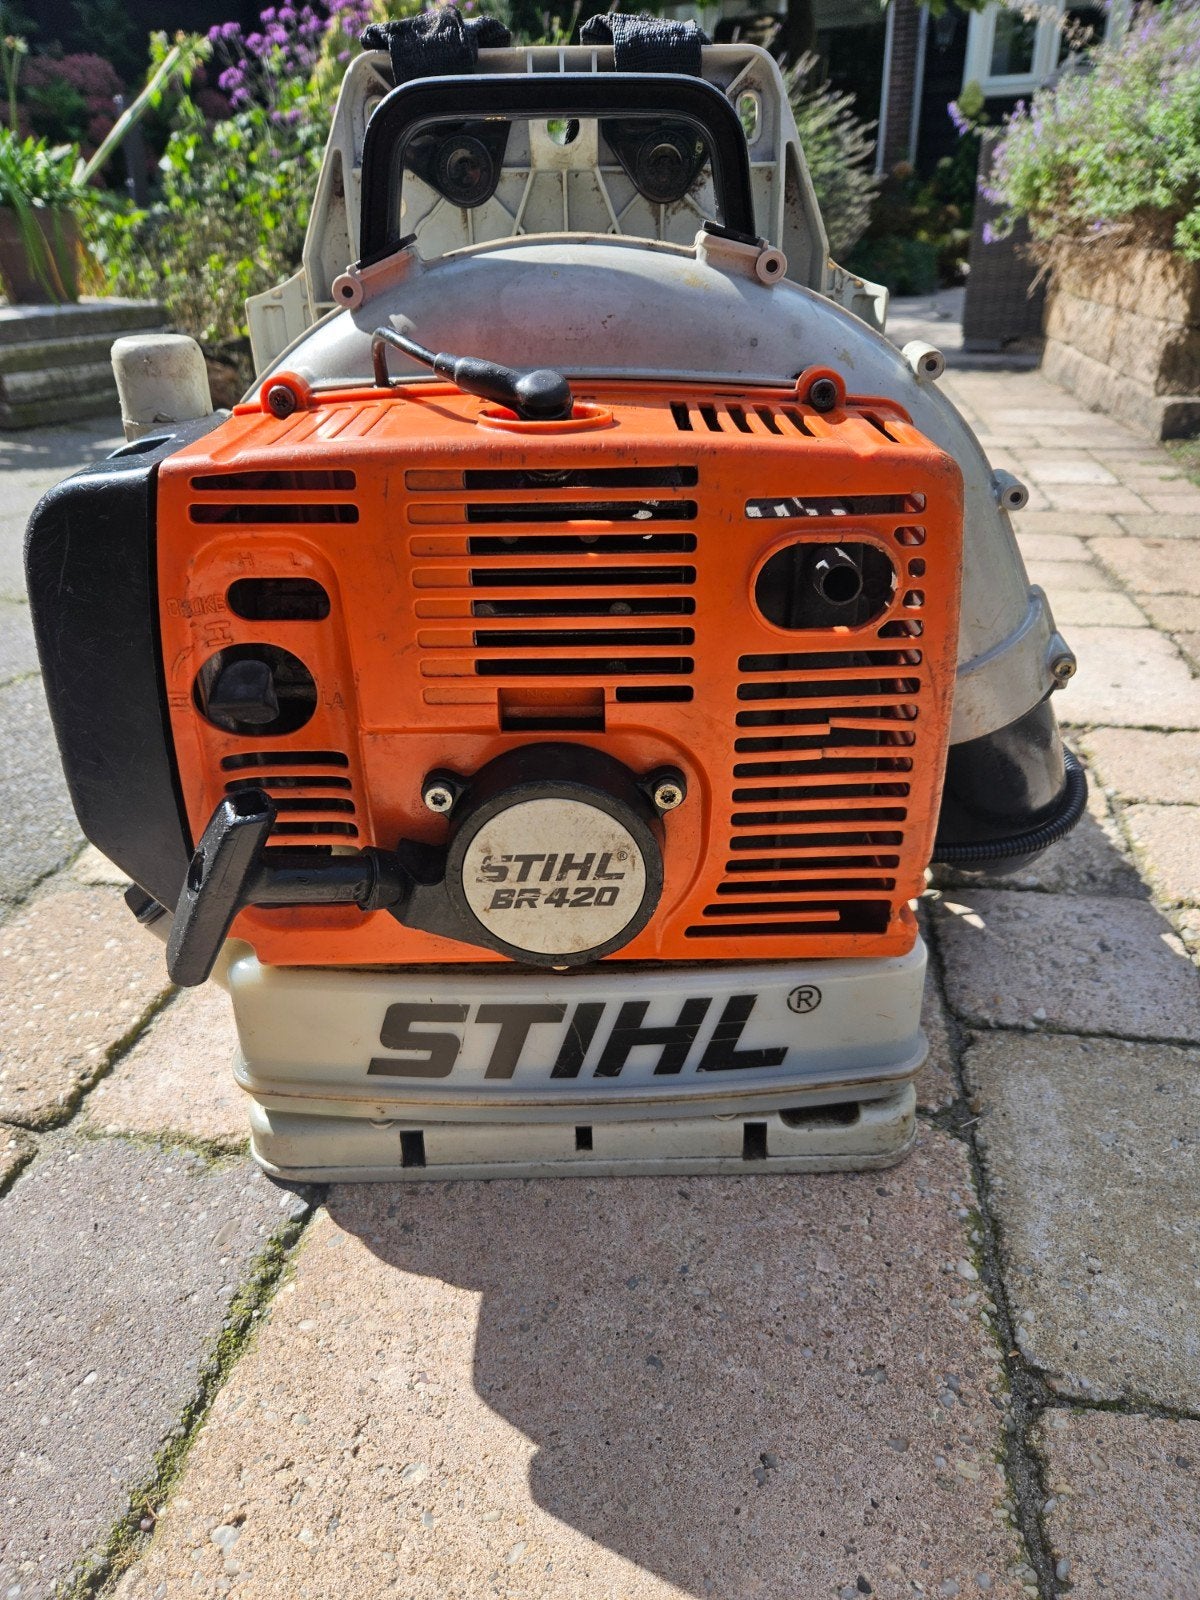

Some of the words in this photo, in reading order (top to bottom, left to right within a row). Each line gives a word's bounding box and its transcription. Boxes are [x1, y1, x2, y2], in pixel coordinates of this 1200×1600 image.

[477, 853, 625, 883] STIHL
[489, 888, 541, 910] BR
[544, 886, 621, 908] 420
[367, 994, 789, 1079] STIHL
